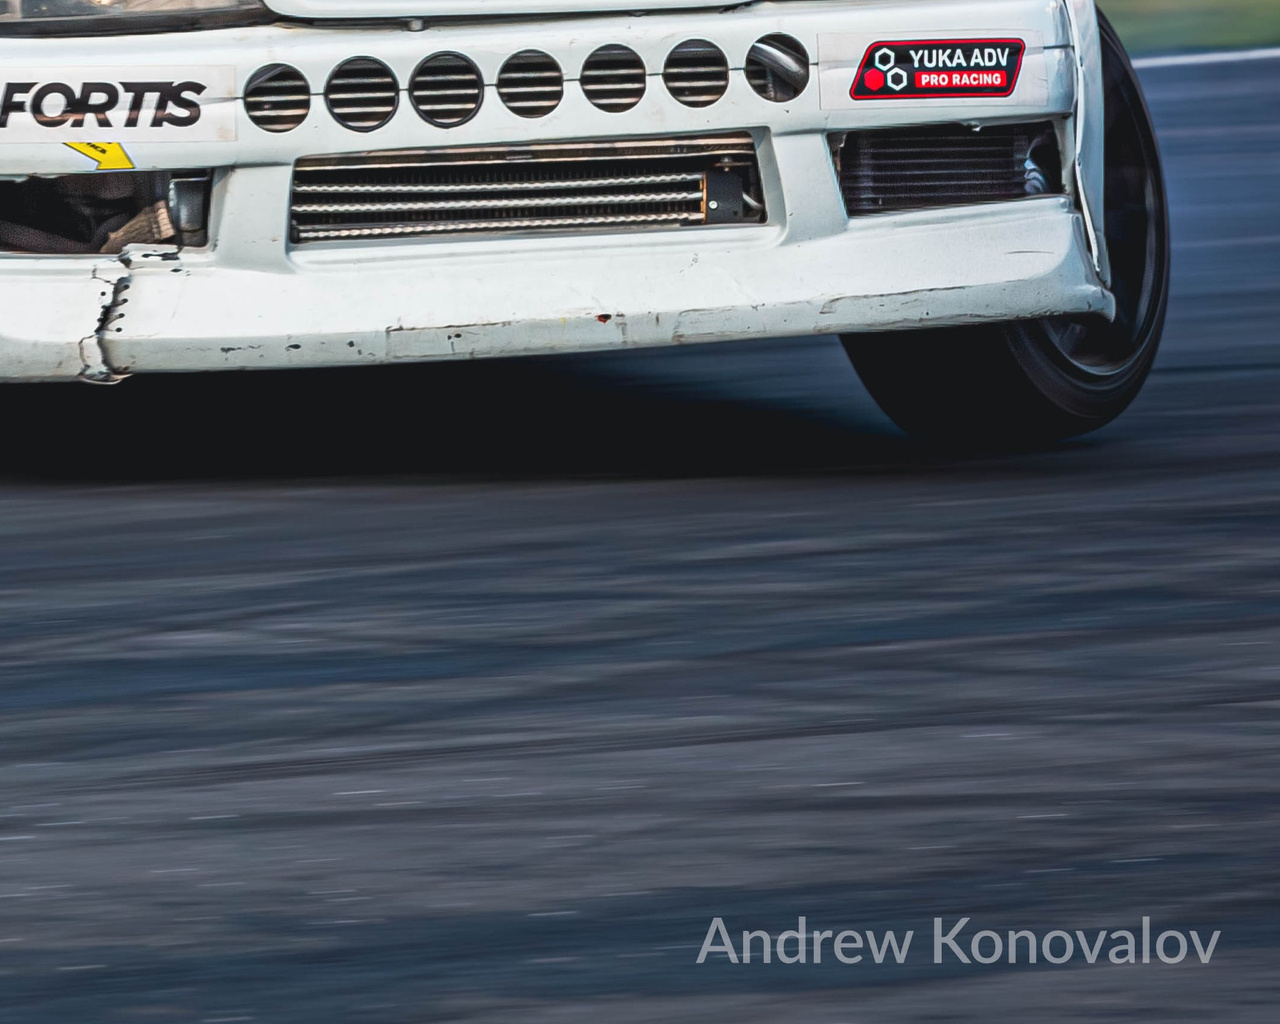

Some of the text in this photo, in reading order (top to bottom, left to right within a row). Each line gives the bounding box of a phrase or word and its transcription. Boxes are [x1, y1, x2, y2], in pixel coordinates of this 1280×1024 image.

[909, 47, 1010, 68] YUKA ADV
[921, 73, 1001, 86] PRO RACING
